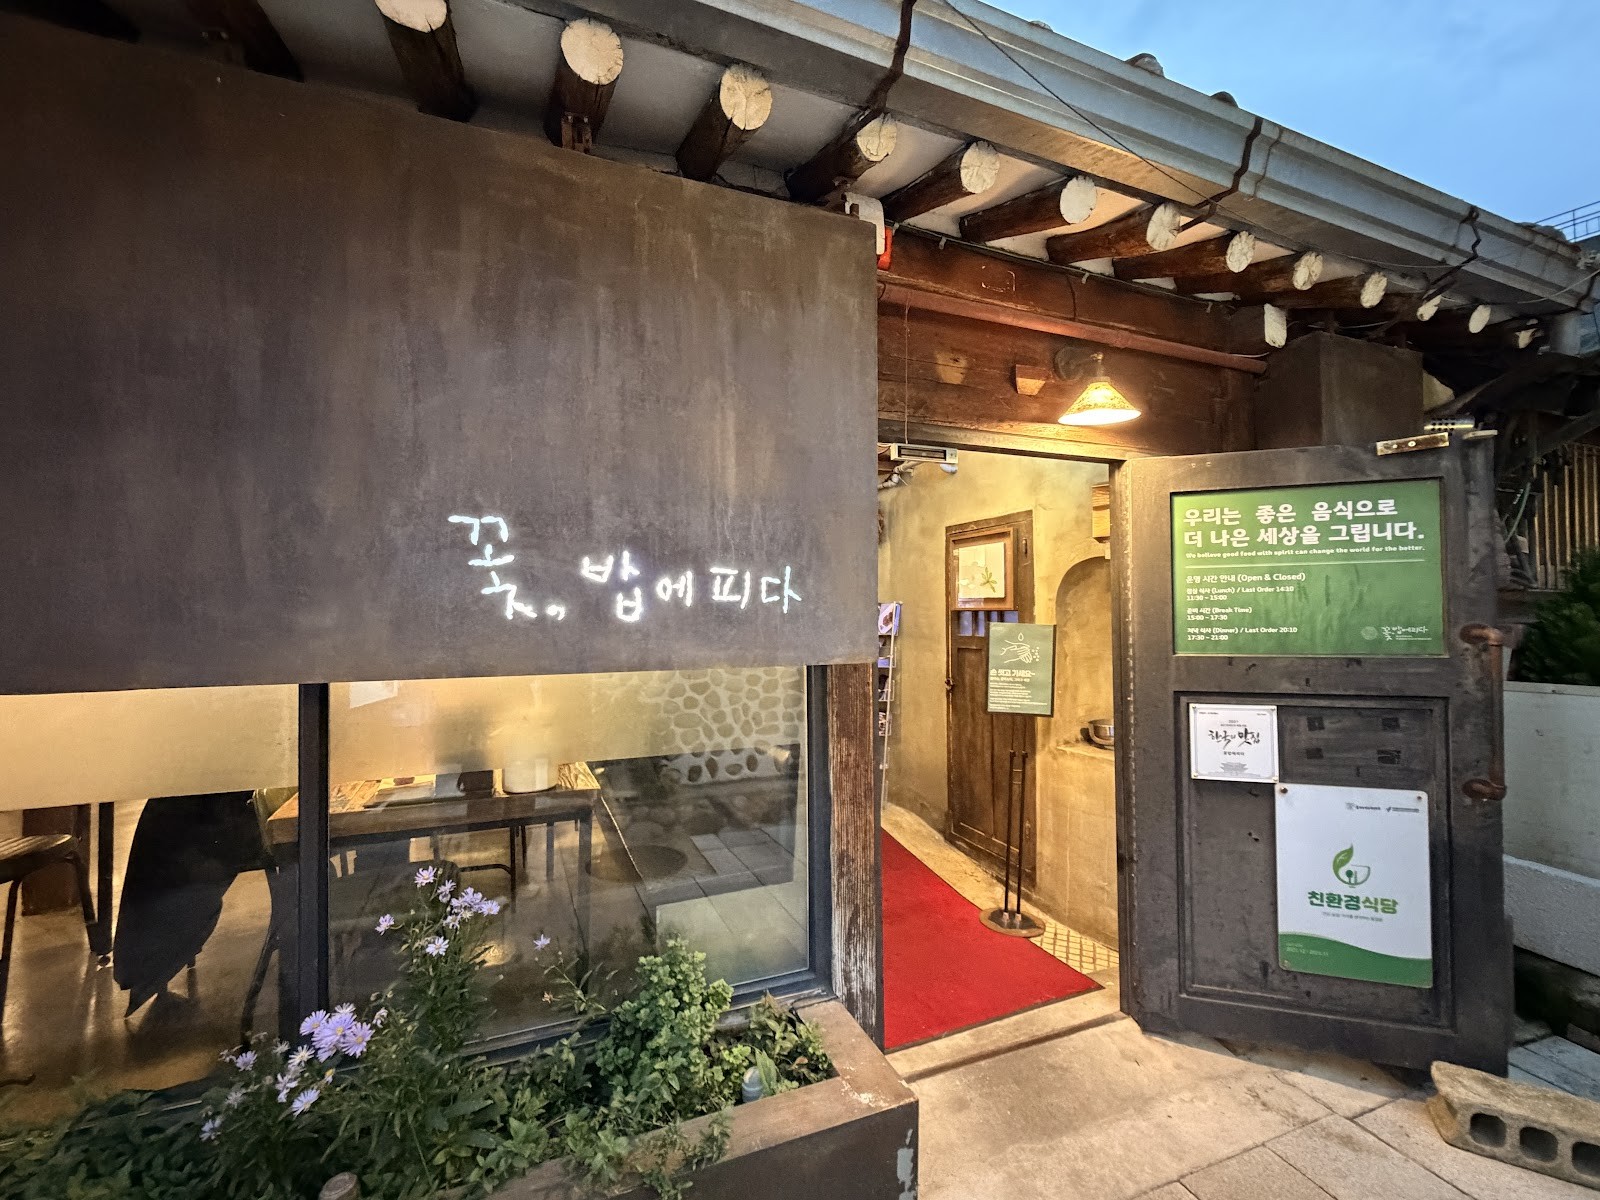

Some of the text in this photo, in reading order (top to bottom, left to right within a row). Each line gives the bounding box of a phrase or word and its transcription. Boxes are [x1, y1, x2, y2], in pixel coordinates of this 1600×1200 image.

[1183, 499, 1398, 527] 우리는 좋은 음식으로
[1183, 521, 1425, 548] 더 나은 세상을 그립니다.
[1274, 549, 1294, 557] spirit
[1202, 575, 1218, 583] 시간
[1219, 574, 1236, 583] 안내
[1237, 573, 1263, 583] (Open
[1264, 573, 1271, 581] &
[1273, 572, 1306, 582] Closed)
[1233, 606, 1253, 614] Time)
[1237, 727, 1261, 748] 맛집
[1307, 890, 1399, 915] 친환경식당
